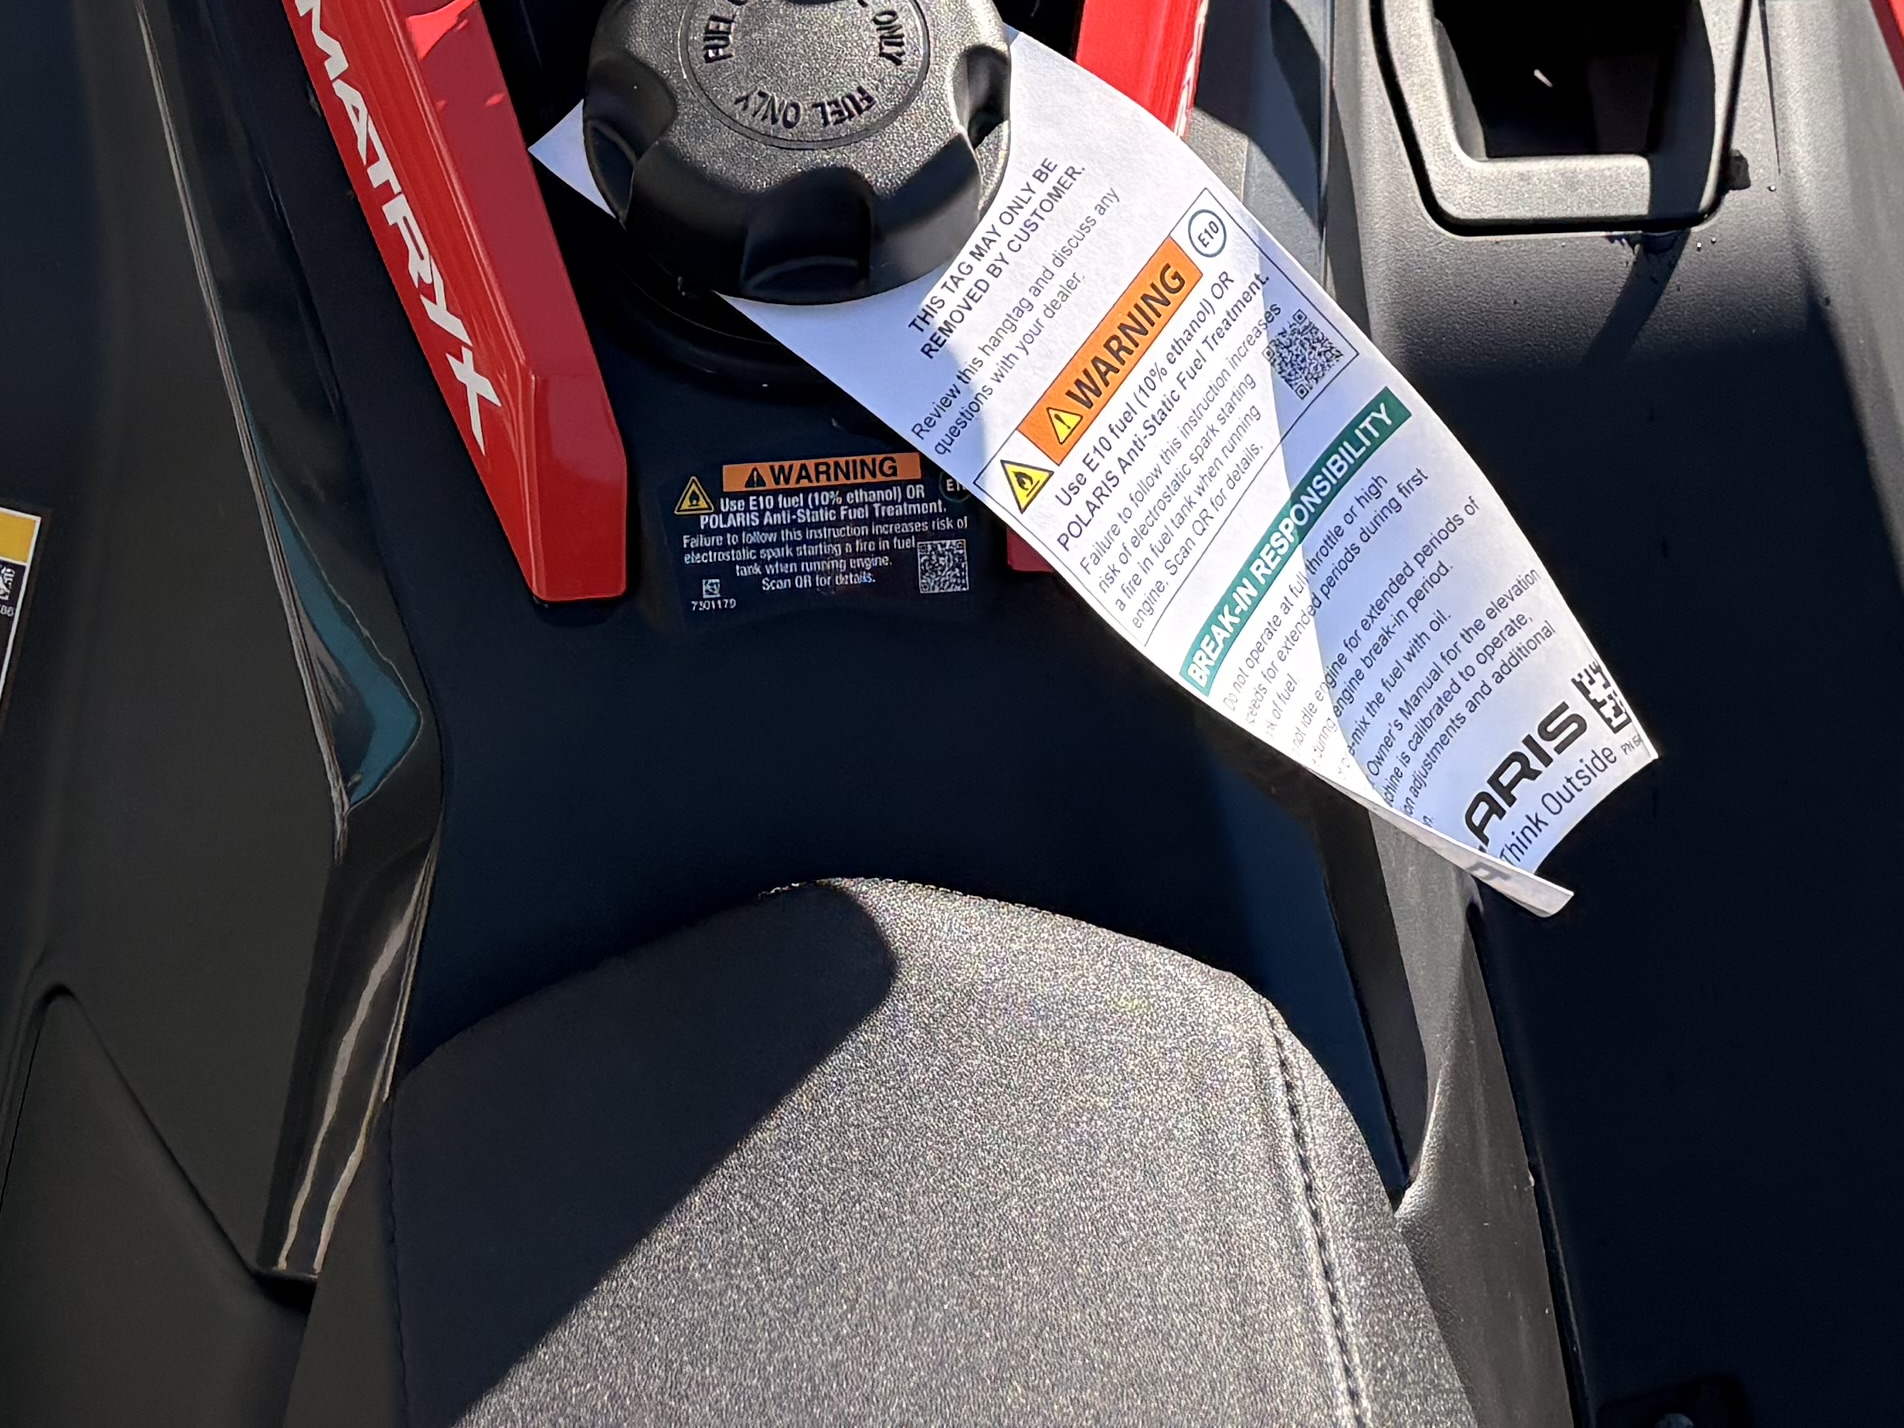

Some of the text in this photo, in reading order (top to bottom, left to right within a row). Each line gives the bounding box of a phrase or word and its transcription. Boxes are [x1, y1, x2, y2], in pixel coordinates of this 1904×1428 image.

[702, 9, 736, 66] FUEL
[734, 84, 877, 130] FUEL ONLY
[870, 8, 907, 67] ONLY
[907, 157, 1058, 333] THIS TAG MAY ONLY BE
[910, 187, 1120, 441] Review this hangtag and discuss any
[920, 165, 1086, 360] REMOVED BY CUSTOMER.
[1064, 220, 1220, 410] WARNING E10
[934, 271, 1085, 455] questions with your dealer.
[1054, 270, 1235, 507] Use E10 fuel (10% ethanol) OR
[1056, 273, 1271, 552] POLARIS Anti-Static Fuel Treatment.
[699, 498, 947, 530] POLARIS Anti-Static Fuel Treatment.
[720, 483, 925, 513] Use E10 fuel (10% ethanol) OR
[768, 456, 898, 486] WARNING
[1187, 402, 1393, 688] BREAK-IN RESPONSIBILITY
[1304, 475, 1388, 576] throttle or high
[1366, 569, 1540, 777] Owner's Manual for the elevation
[1464, 701, 1588, 848] ARIS
[1499, 747, 1618, 866] Think Outside
